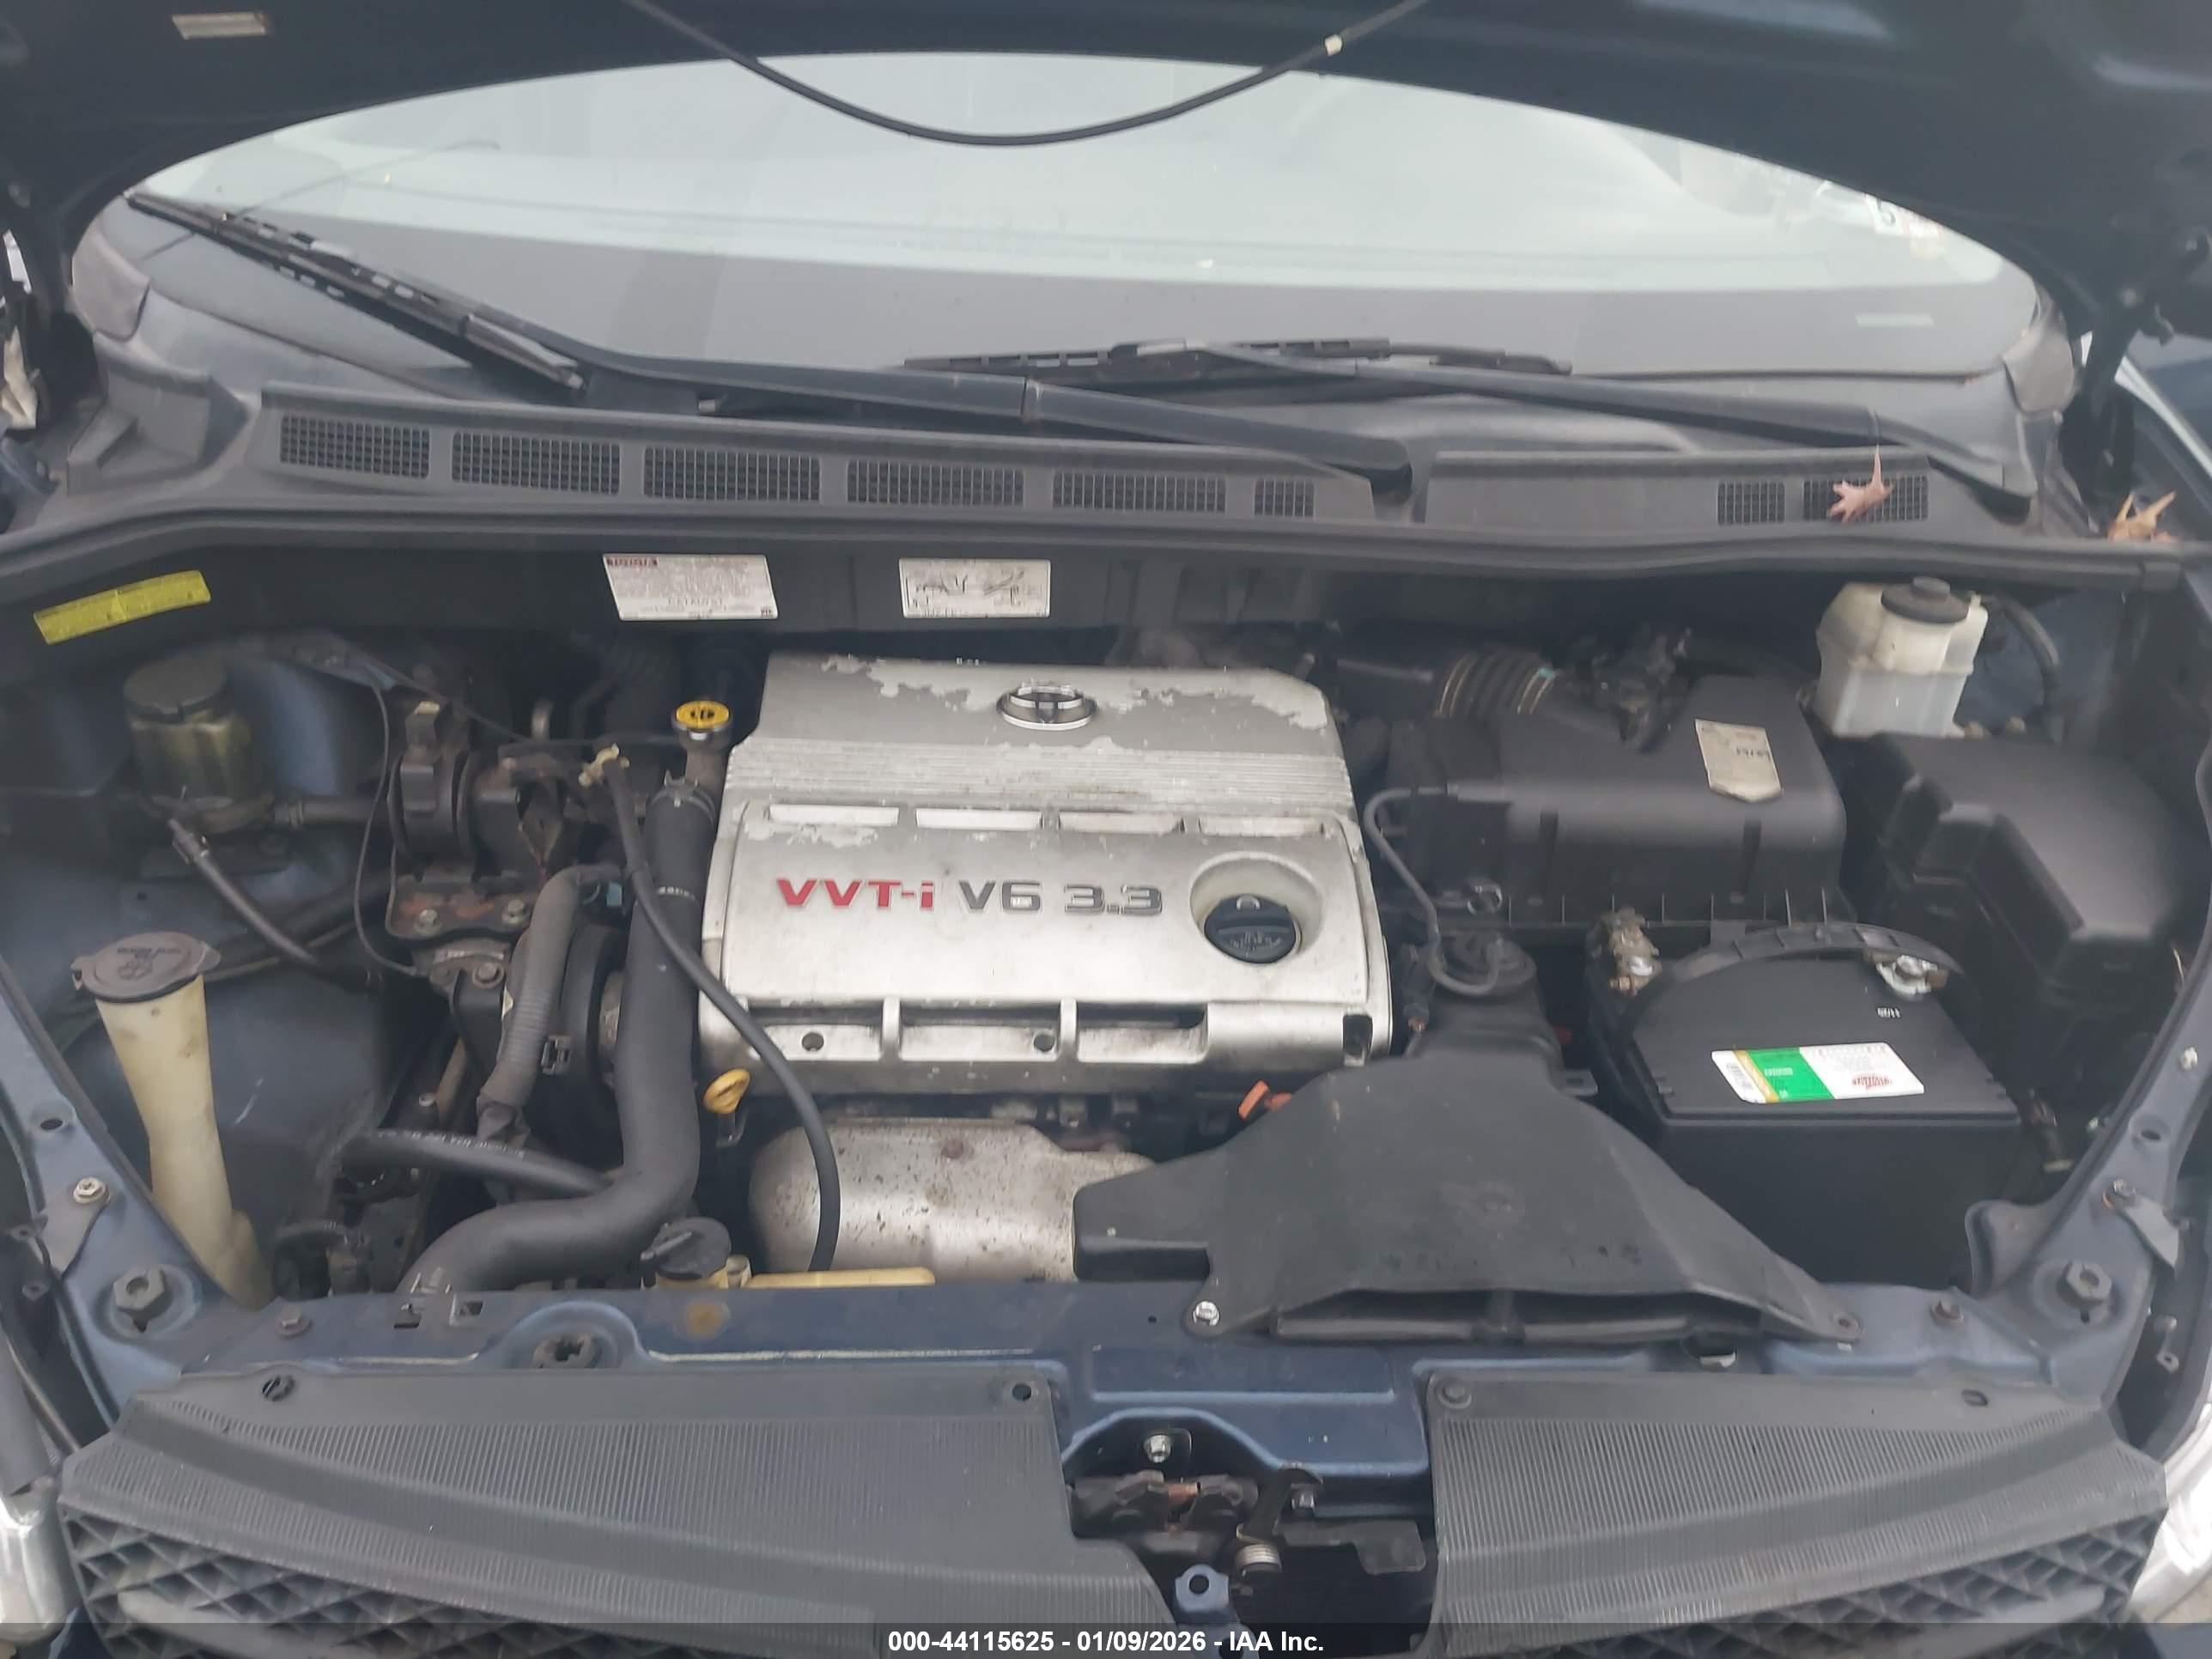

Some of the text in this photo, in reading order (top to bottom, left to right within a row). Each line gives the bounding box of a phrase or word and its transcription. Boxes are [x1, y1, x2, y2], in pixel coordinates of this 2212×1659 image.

[776, 878, 1163, 915] VVT-i V6 3.3
